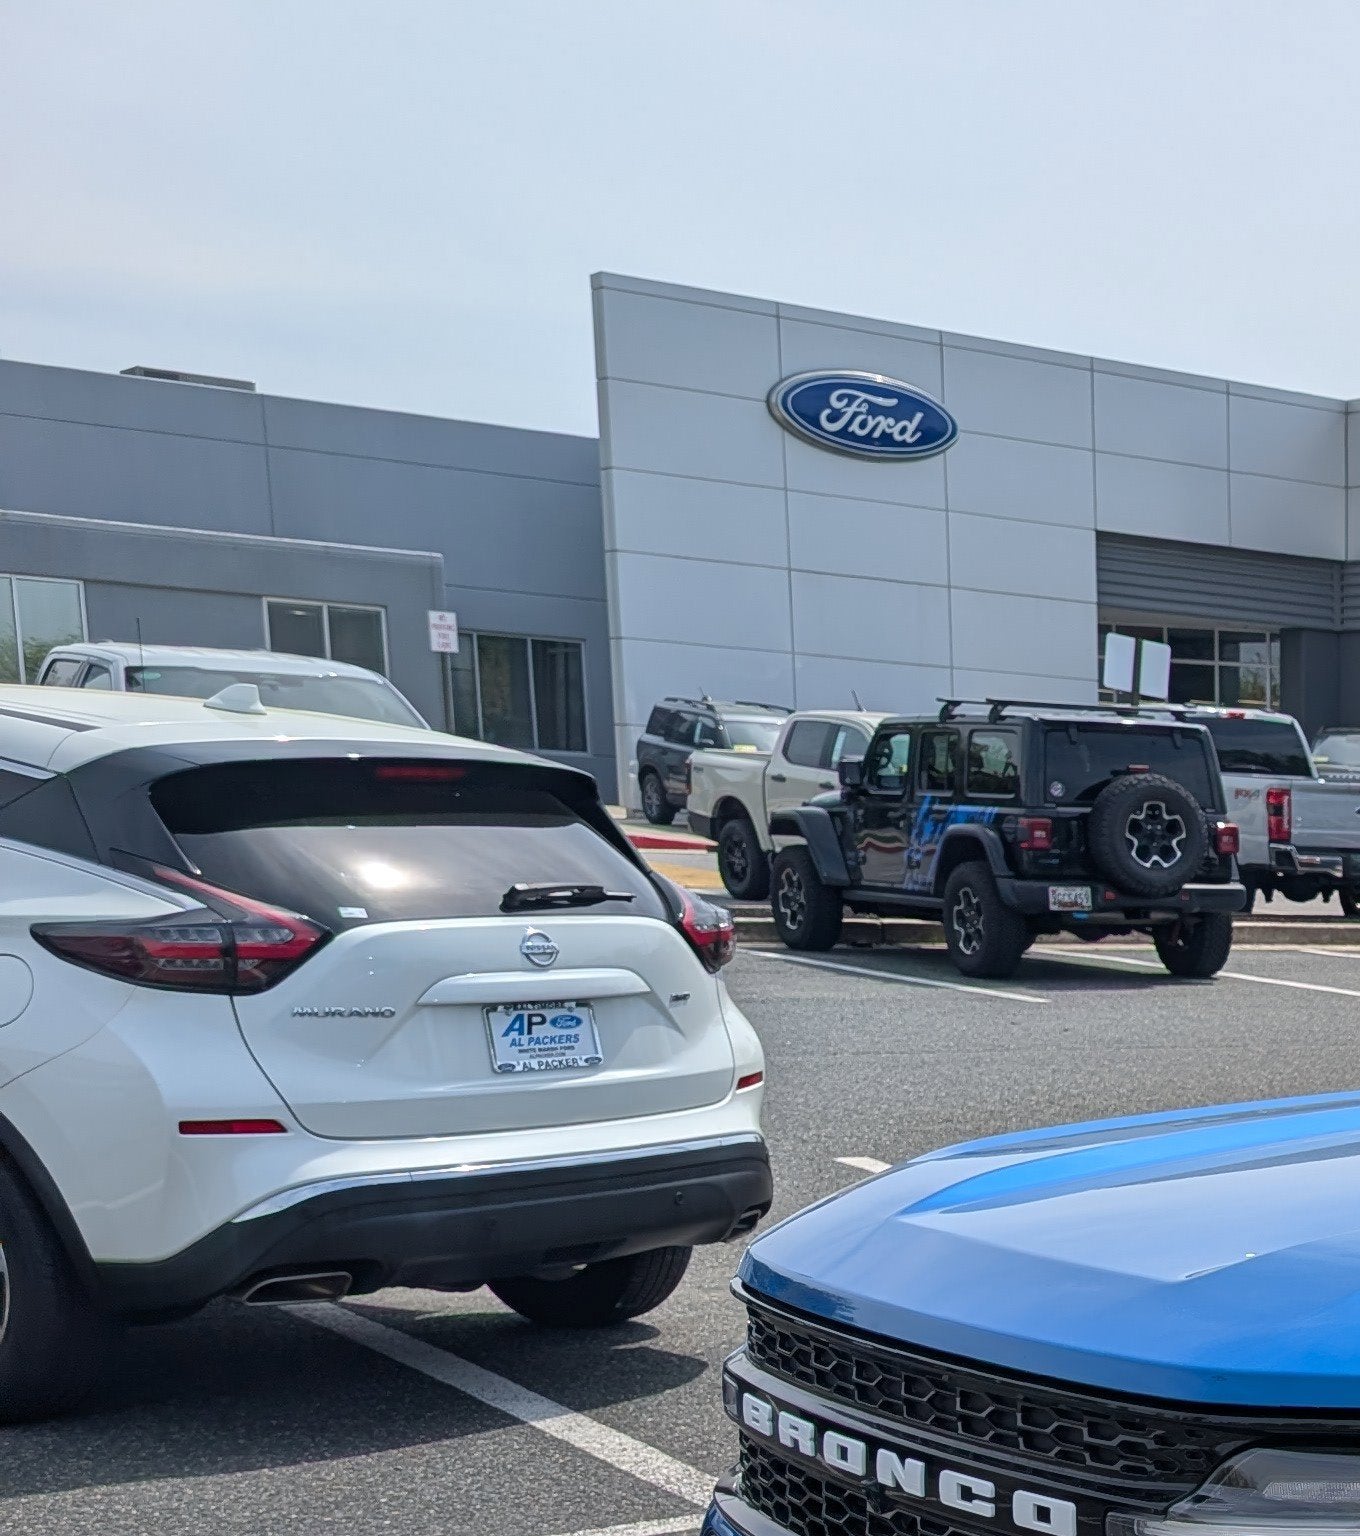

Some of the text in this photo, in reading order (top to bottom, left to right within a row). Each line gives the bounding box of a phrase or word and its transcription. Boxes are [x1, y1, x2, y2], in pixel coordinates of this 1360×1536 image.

[819, 388, 924, 444] Ford
[292, 1006, 396, 1019] MURANO
[502, 1013, 547, 1037] AP
[510, 1033, 580, 1048] AL PACKERS
